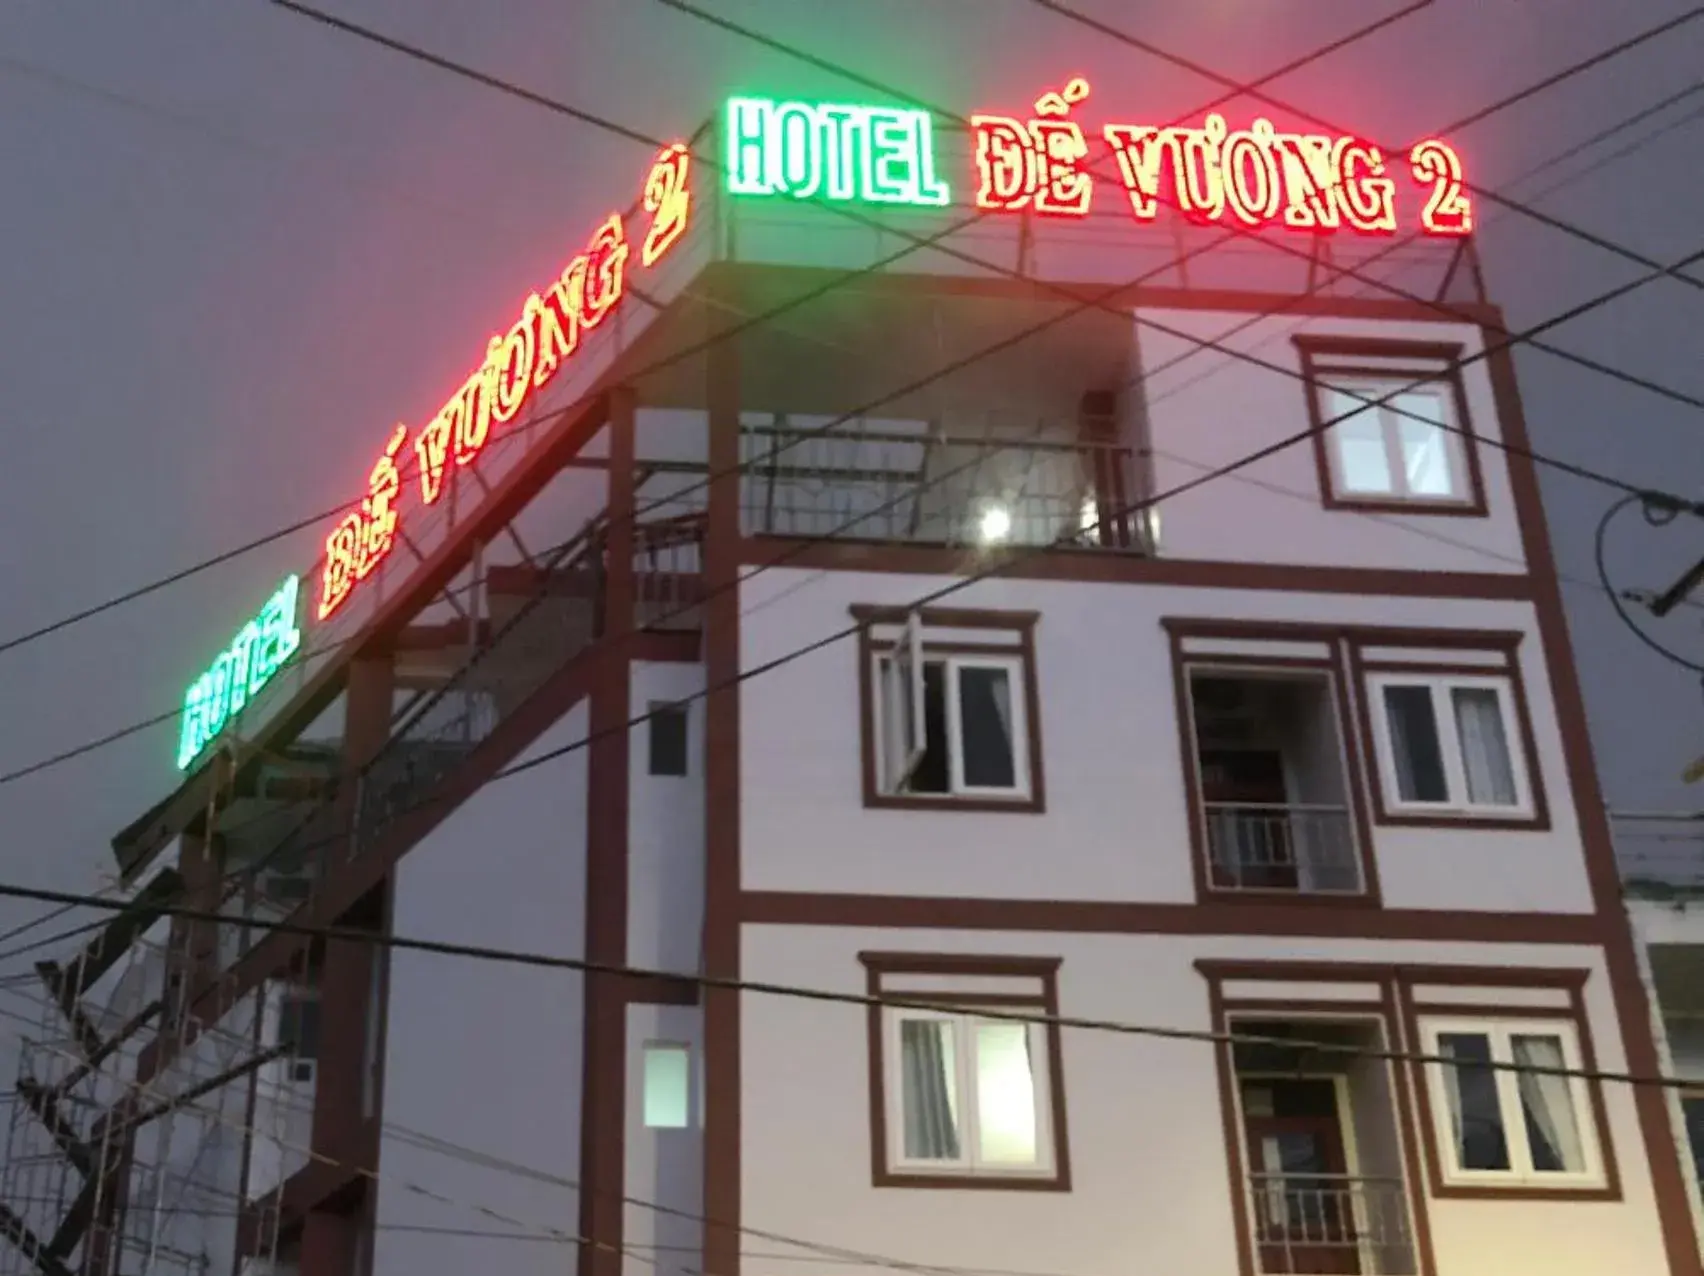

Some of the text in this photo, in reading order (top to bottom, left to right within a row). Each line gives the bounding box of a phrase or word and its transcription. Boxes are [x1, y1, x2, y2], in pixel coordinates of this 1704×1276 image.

[728, 78, 1474, 234] HOTEL ĐẾ VƯƠNG 2
[177, 573, 300, 771] HOTEL
[642, 143, 691, 267] 2
